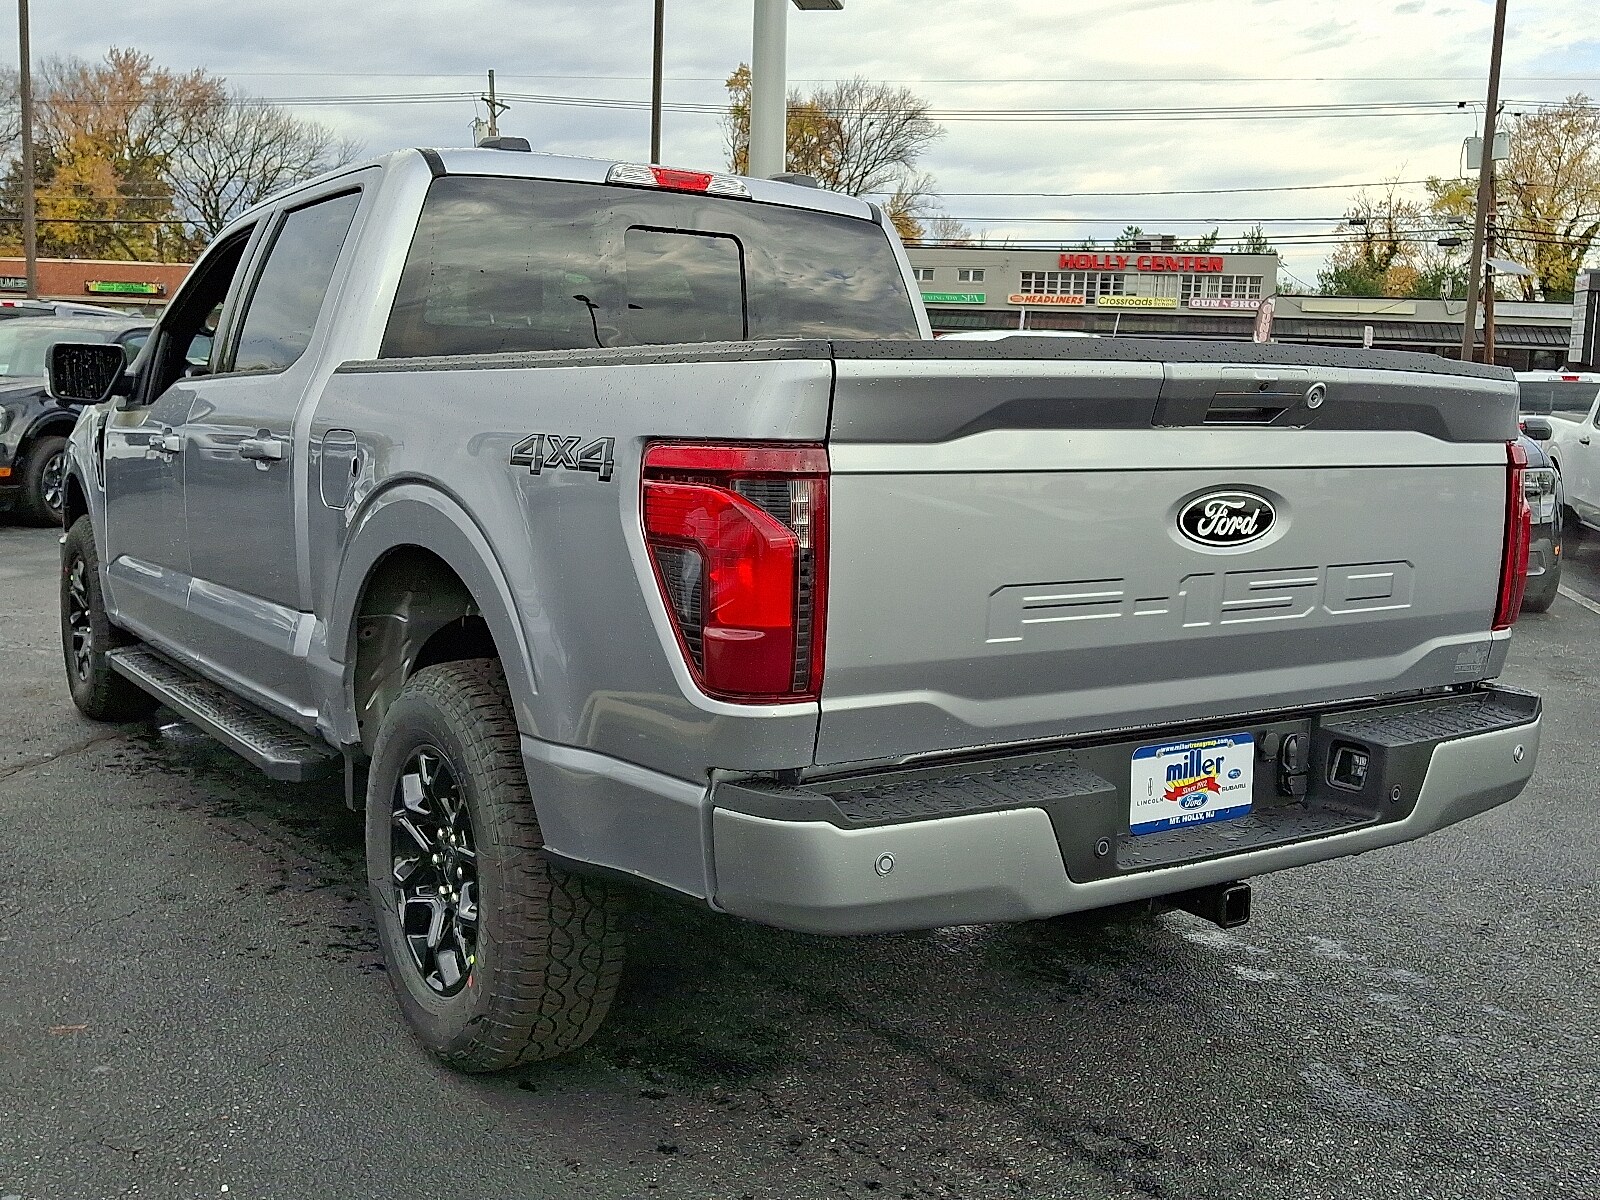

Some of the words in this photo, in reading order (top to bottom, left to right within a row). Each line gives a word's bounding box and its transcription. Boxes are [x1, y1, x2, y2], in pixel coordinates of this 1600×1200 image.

[1059, 254, 1129, 271] HOLLY
[1136, 255, 1223, 272] CENTER
[961, 294, 978, 302] SPA
[1024, 295, 1084, 304] HEADLINERS
[1098, 296, 1153, 306] Crossroads
[1191, 299, 1221, 308] GUN
[1230, 300, 1262, 308] SHO
[1197, 500, 1259, 536] Ford
[986, 560, 1415, 643] F-150
[1166, 749, 1225, 782] miller
[1221, 783, 1246, 792] SUBARU
[1136, 797, 1164, 806] LINCOLN
[1169, 816, 1180, 825] MT.
[1206, 810, 1215, 819] NJ
